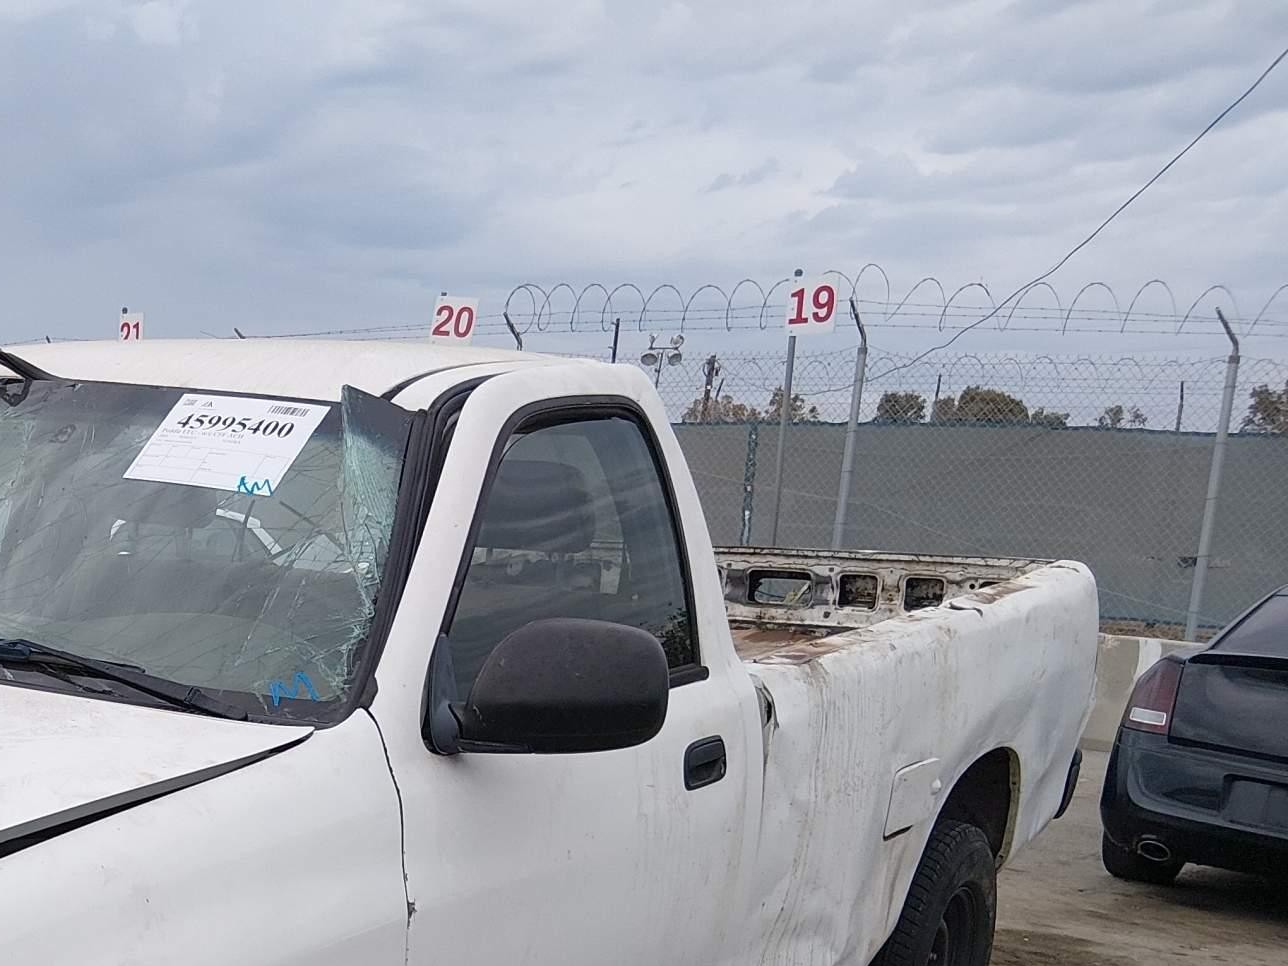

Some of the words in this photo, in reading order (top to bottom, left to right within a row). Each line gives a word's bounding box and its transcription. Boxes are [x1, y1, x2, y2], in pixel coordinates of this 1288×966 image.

[788, 285, 834, 324] 19
[120, 321, 140, 341] 21
[432, 305, 473, 338] 20
[176, 413, 294, 439] 45995400
